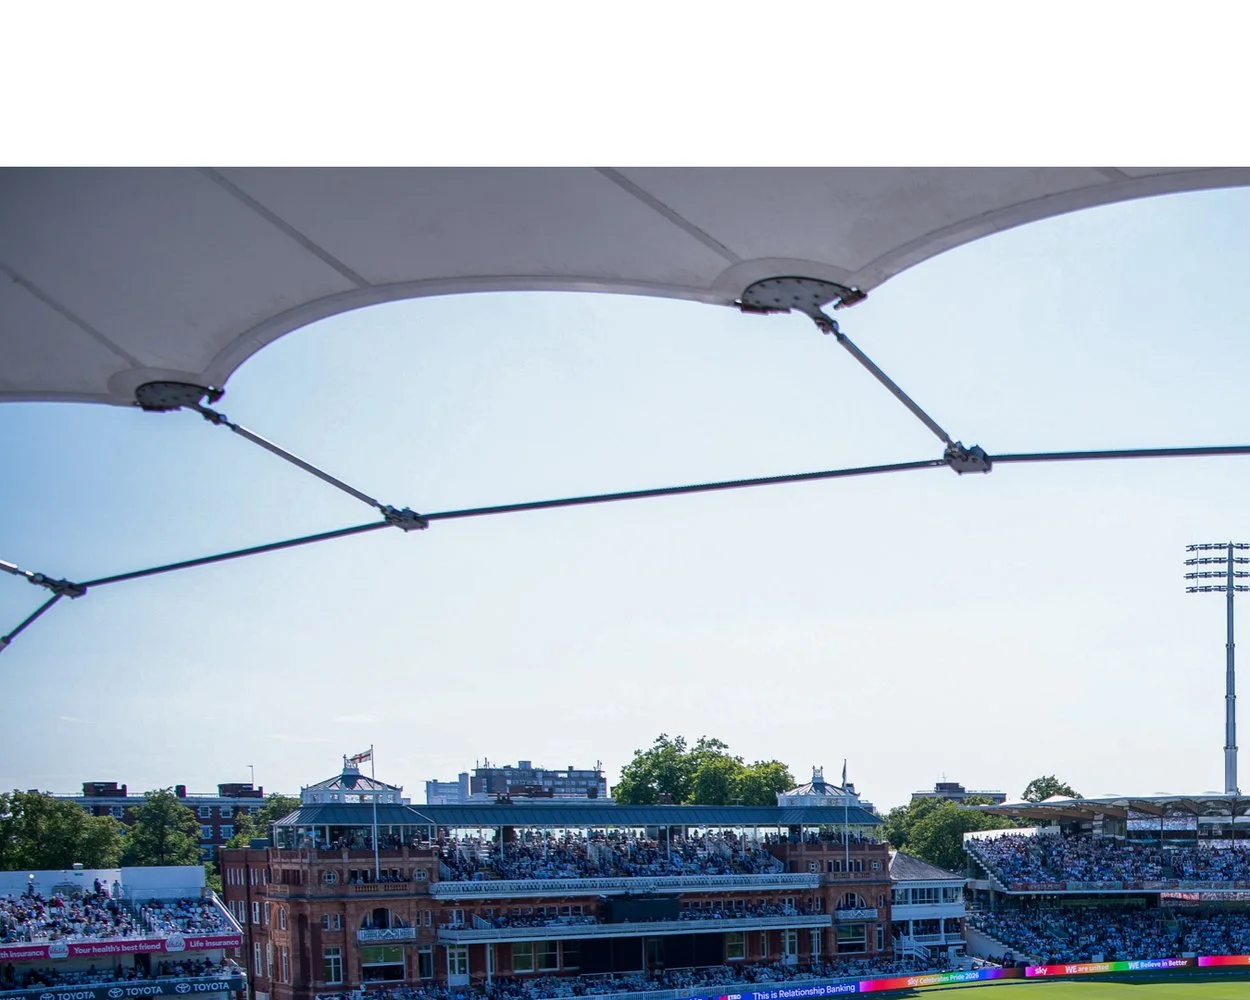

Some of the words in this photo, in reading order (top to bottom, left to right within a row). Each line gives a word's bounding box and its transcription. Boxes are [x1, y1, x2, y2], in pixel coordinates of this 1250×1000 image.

[1065, 965, 1077, 973] WE
[1128, 961, 1140, 970] WE
[1140, 960, 1161, 968] Believe
[1168, 959, 1187, 967] Better
[1035, 966, 1048, 975] sky
[907, 977, 918, 986] sky
[920, 974, 949, 984] Celebrates
[126, 986, 163, 996] TOYOTA
[193, 982, 230, 992] TOYOTA
[753, 992, 770, 1000] This
[771, 991, 777, 999] is
[779, 986, 825, 998] Relationship
[827, 984, 855, 994] Banking
